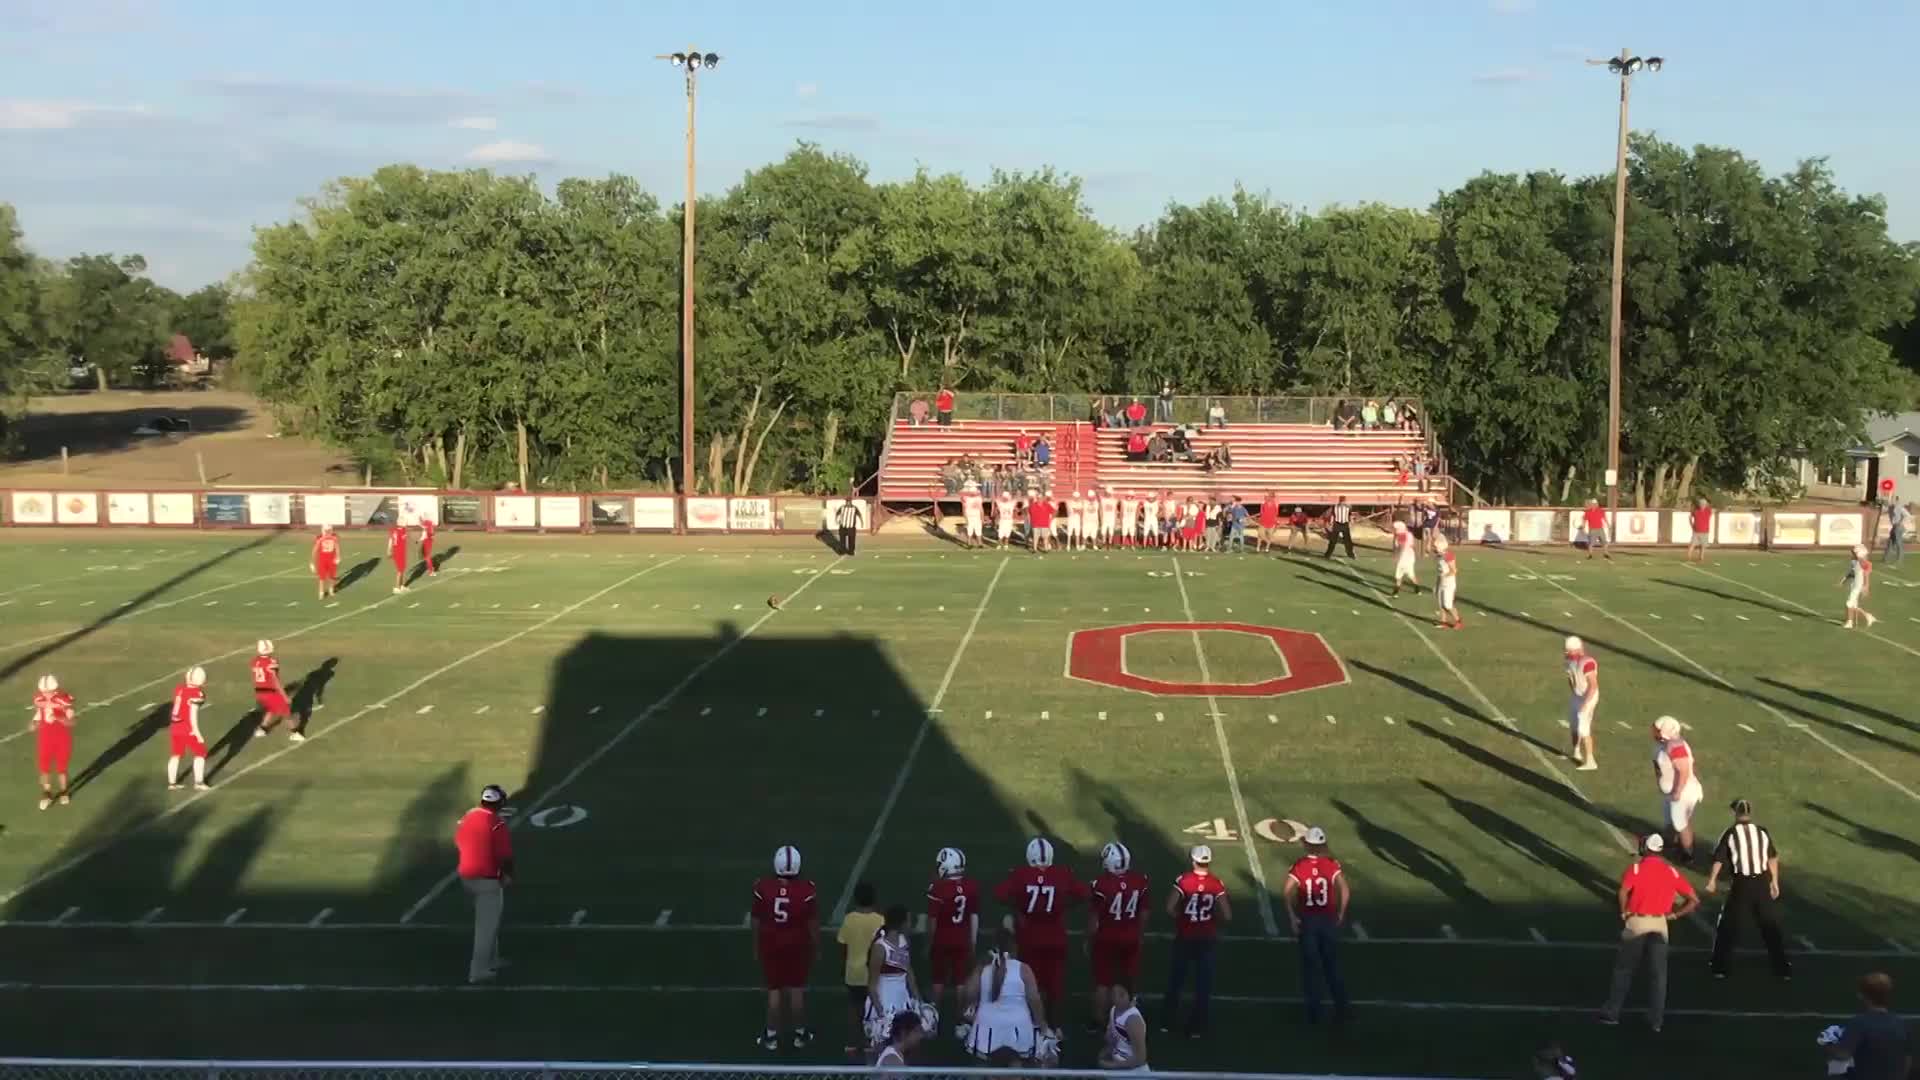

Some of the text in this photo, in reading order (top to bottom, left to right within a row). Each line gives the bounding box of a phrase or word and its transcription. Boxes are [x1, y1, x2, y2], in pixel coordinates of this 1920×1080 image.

[1025, 884, 1056, 914] 77
[1108, 888, 1140, 921] 44
[1304, 876, 1329, 907] 13
[773, 897, 791, 923] 5
[951, 895, 968, 924] 3
[1184, 892, 1215, 923] 42
